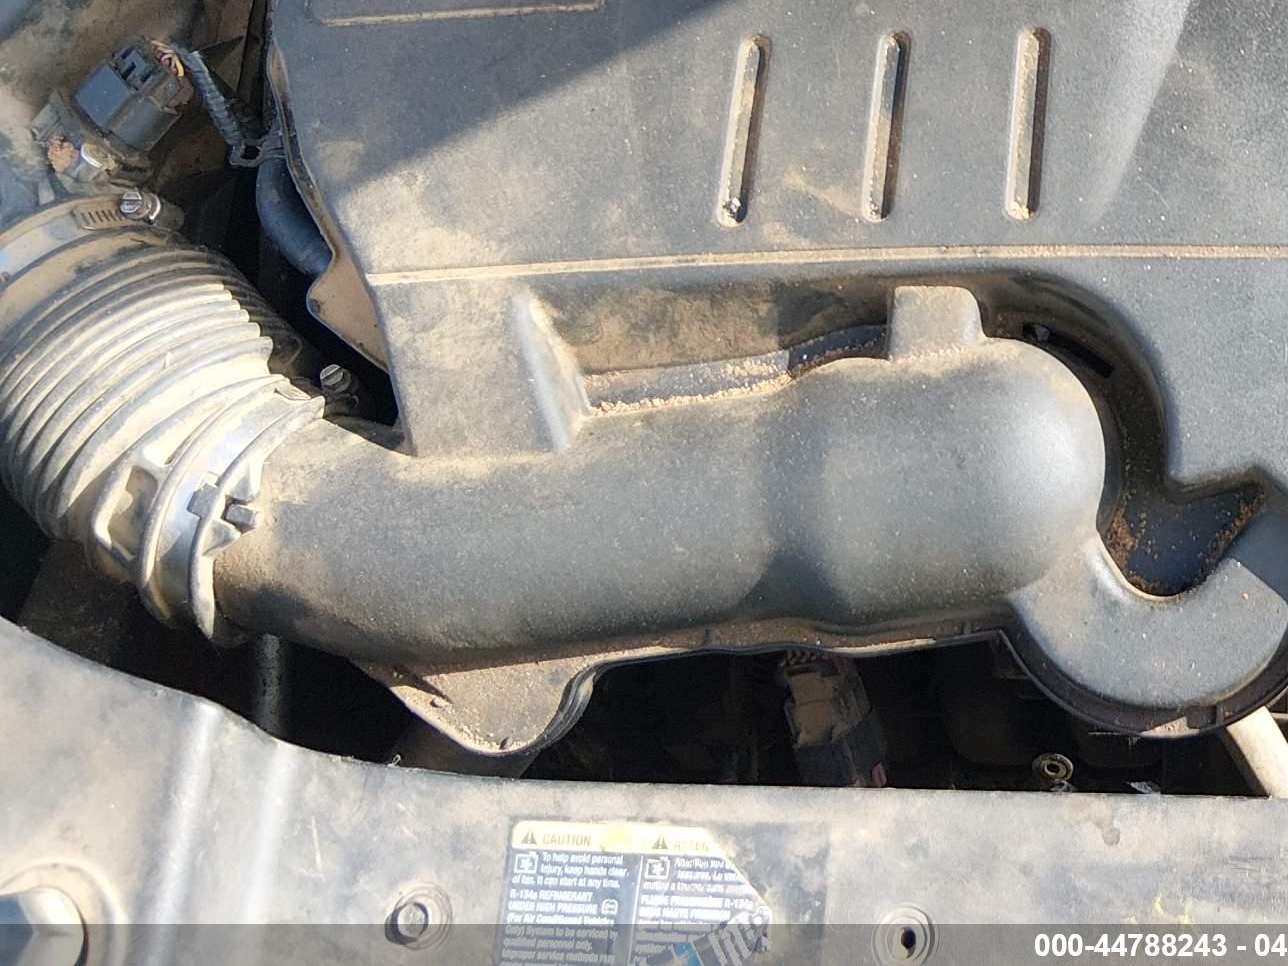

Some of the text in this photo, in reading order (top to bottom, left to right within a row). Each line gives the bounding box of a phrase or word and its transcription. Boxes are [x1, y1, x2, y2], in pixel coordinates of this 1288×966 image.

[542, 833, 592, 846] CAUTION
[542, 852, 624, 867] To help avoid personal
